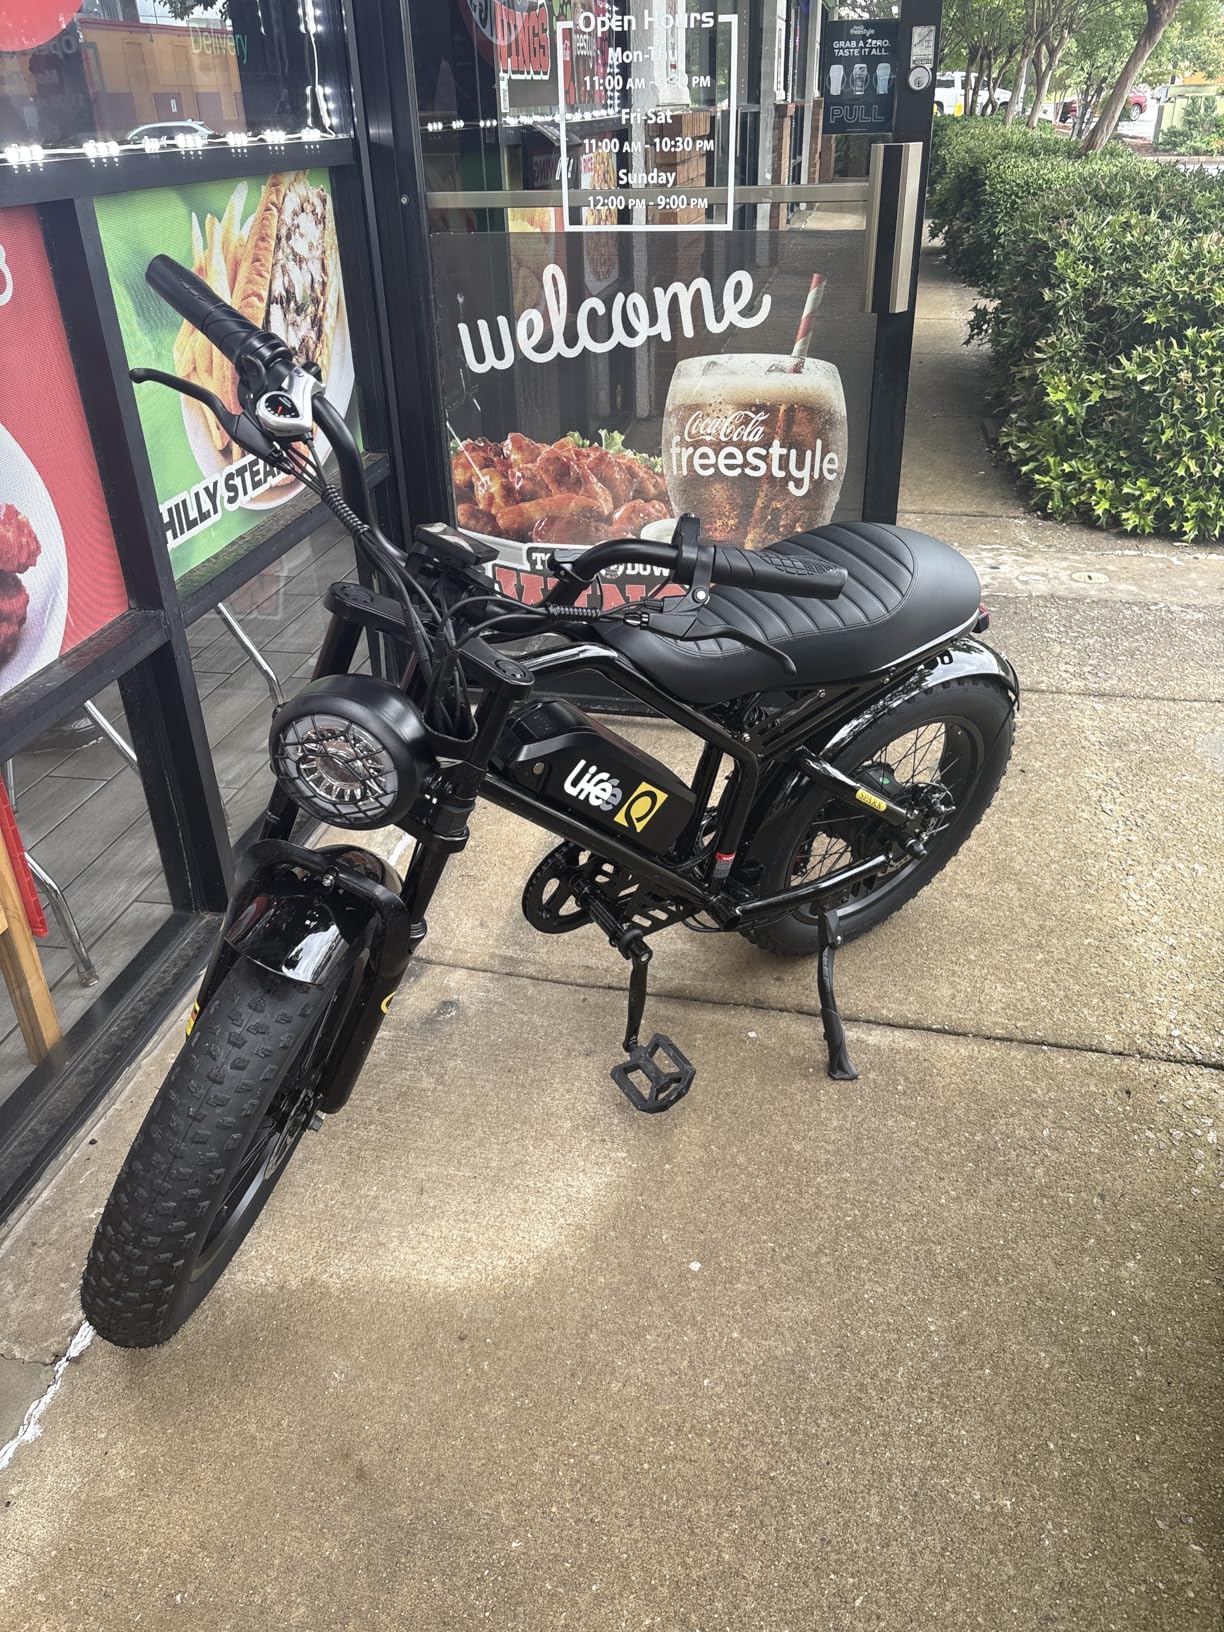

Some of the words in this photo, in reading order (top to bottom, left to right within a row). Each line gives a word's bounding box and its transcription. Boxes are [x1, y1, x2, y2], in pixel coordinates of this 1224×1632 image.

[578, 11, 636, 37] Open
[644, 10, 714, 30] Hours
[850, 28, 875, 37] freestyle
[190, 23, 247, 64] Delivery
[833, 40, 857, 49] GRAB
[866, 39, 891, 48] ZERO.
[834, 49, 860, 57] TASTE
[861, 48, 869, 56] IT
[871, 48, 889, 56] ALL.
[584, 75, 623, 91] 11:00
[626, 78, 645, 90] AM
[692, 75, 711, 88] PM
[621, 108, 673, 125] Fri-Sat
[830, 105, 884, 123] PULL
[583, 138, 619, 154] 11:00
[623, 141, 641, 153] AM
[654, 137, 692, 152] 10:30
[696, 139, 714, 151] PM
[618, 168, 676, 187] Sunday
[588, 196, 625, 210] 12:00
[628, 198, 646, 209] PM
[657, 195, 687, 209] 9:00
[690, 197, 708, 208] PM
[458, 264, 772, 373] welcome
[669, 435, 839, 497] freestyle
[160, 479, 219, 541] HILLY
[224, 455, 283, 505] STEA
